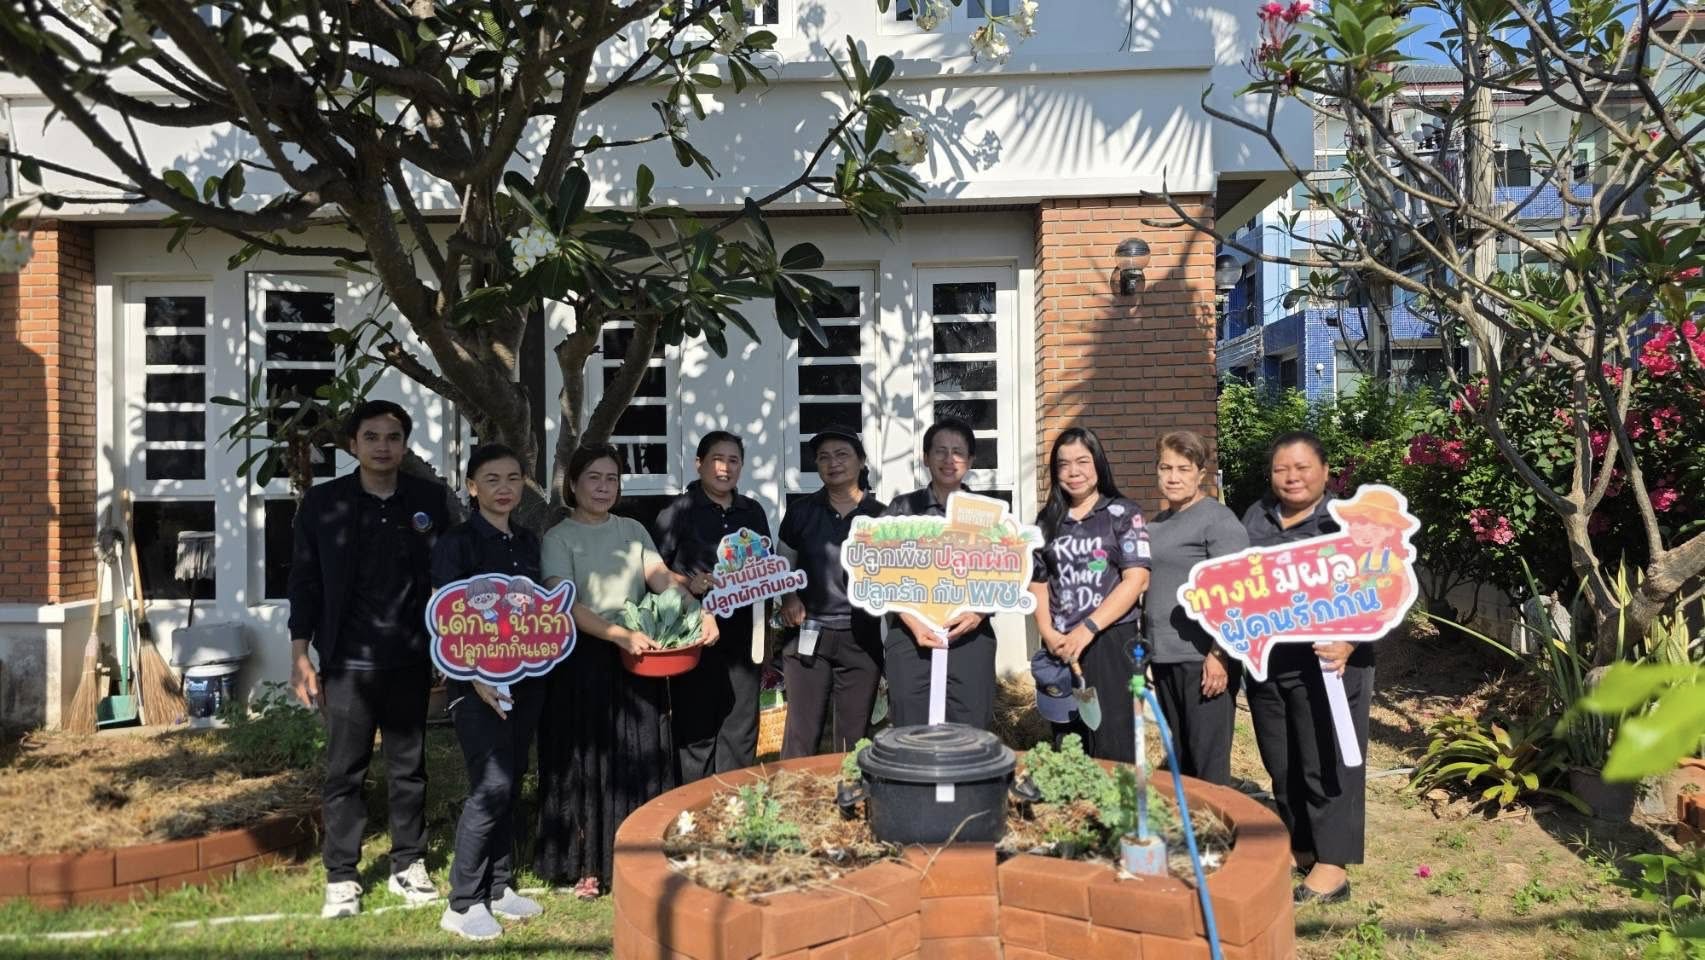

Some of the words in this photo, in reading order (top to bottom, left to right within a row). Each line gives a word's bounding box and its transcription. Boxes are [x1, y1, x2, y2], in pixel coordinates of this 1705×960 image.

[847, 540, 931, 575] ปลูกพืช
[934, 542, 1021, 578] ปลูกผัก
[1052, 534, 1102, 561] Run
[706, 573, 804, 613] ปลูกผักกินเอง
[854, 576, 928, 610] ปลูกรัก
[932, 577, 966, 605] กับ
[967, 579, 1032, 609] พช.
[1076, 586, 1103, 612] Do
[1185, 553, 1270, 613] ทางนี้
[509, 602, 570, 635] น่ารัก
[1220, 582, 1382, 653] ผู้คนรักกัน
[450, 635, 559, 666] ปลูกผักกินเอง
